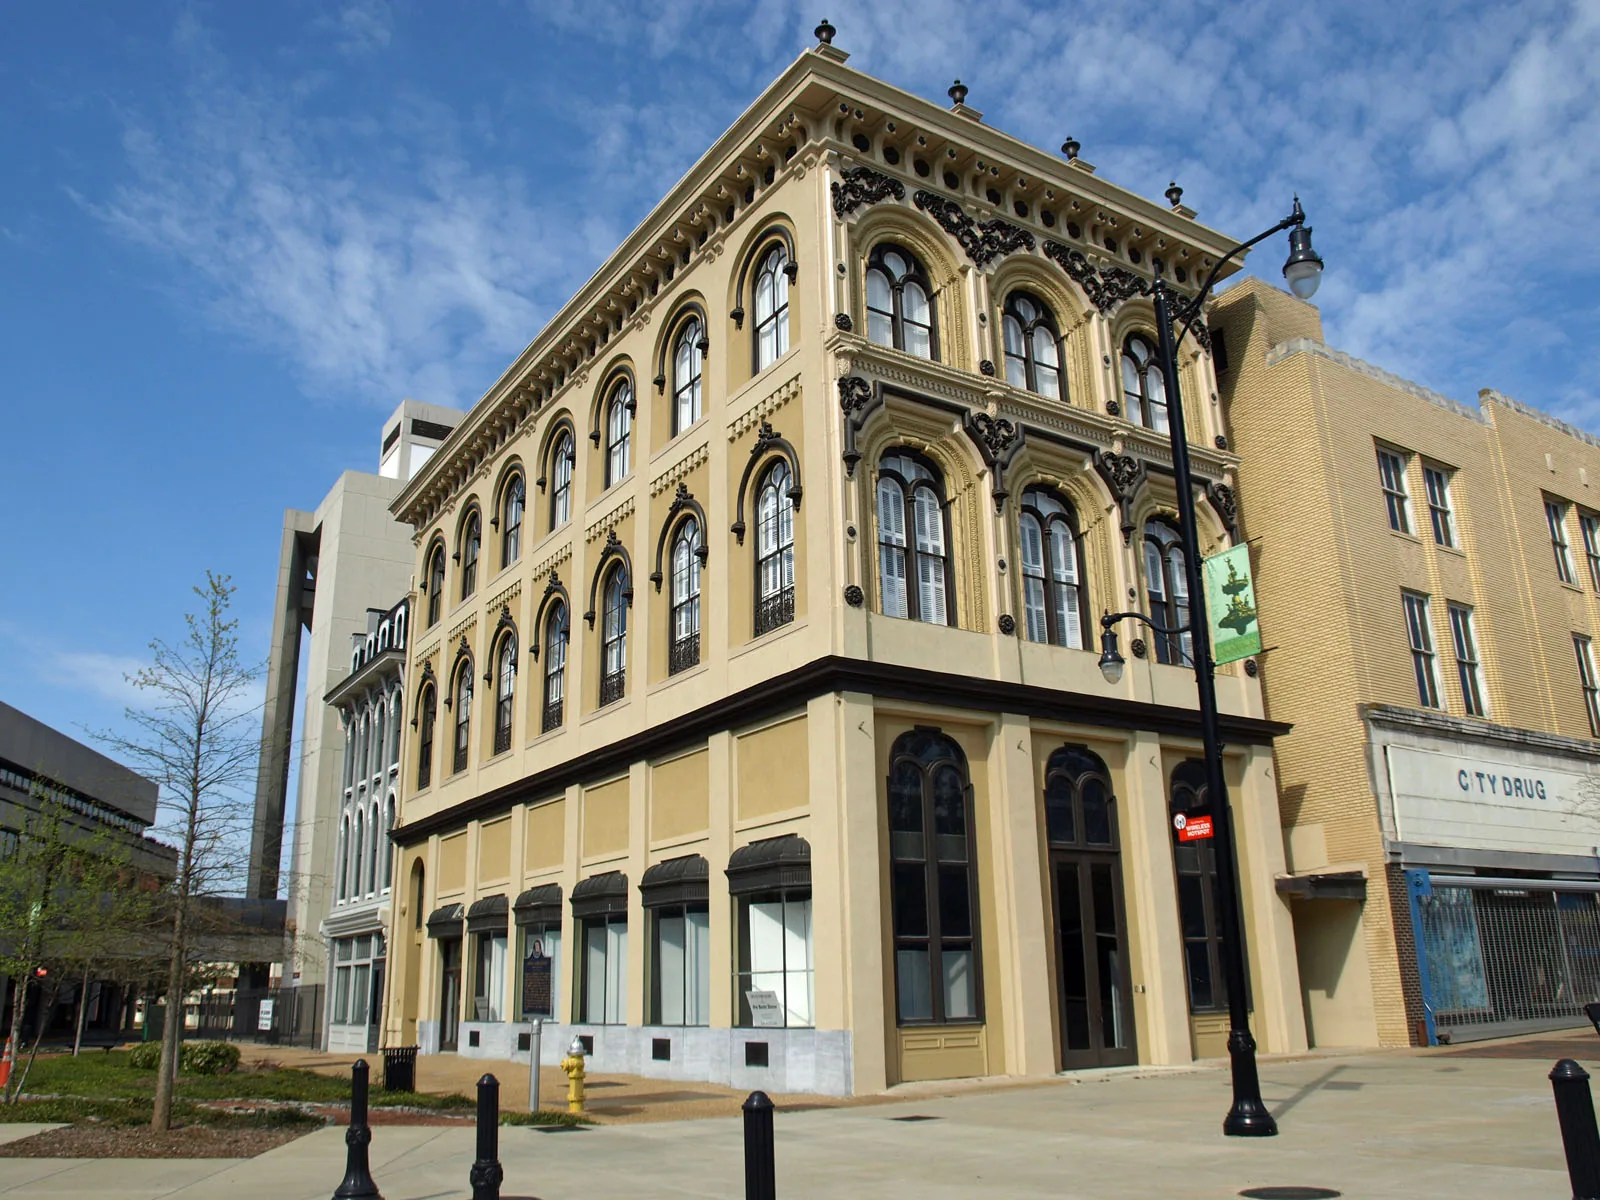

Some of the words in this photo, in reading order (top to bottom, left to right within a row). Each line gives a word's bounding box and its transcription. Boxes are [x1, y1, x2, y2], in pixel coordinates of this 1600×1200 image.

[1458, 769, 1496, 794] CTY
[1502, 776, 1546, 800] DRUG
[1186, 822, 1210, 832] WIRELESS
[1187, 828, 1210, 837] HOTSPOT
